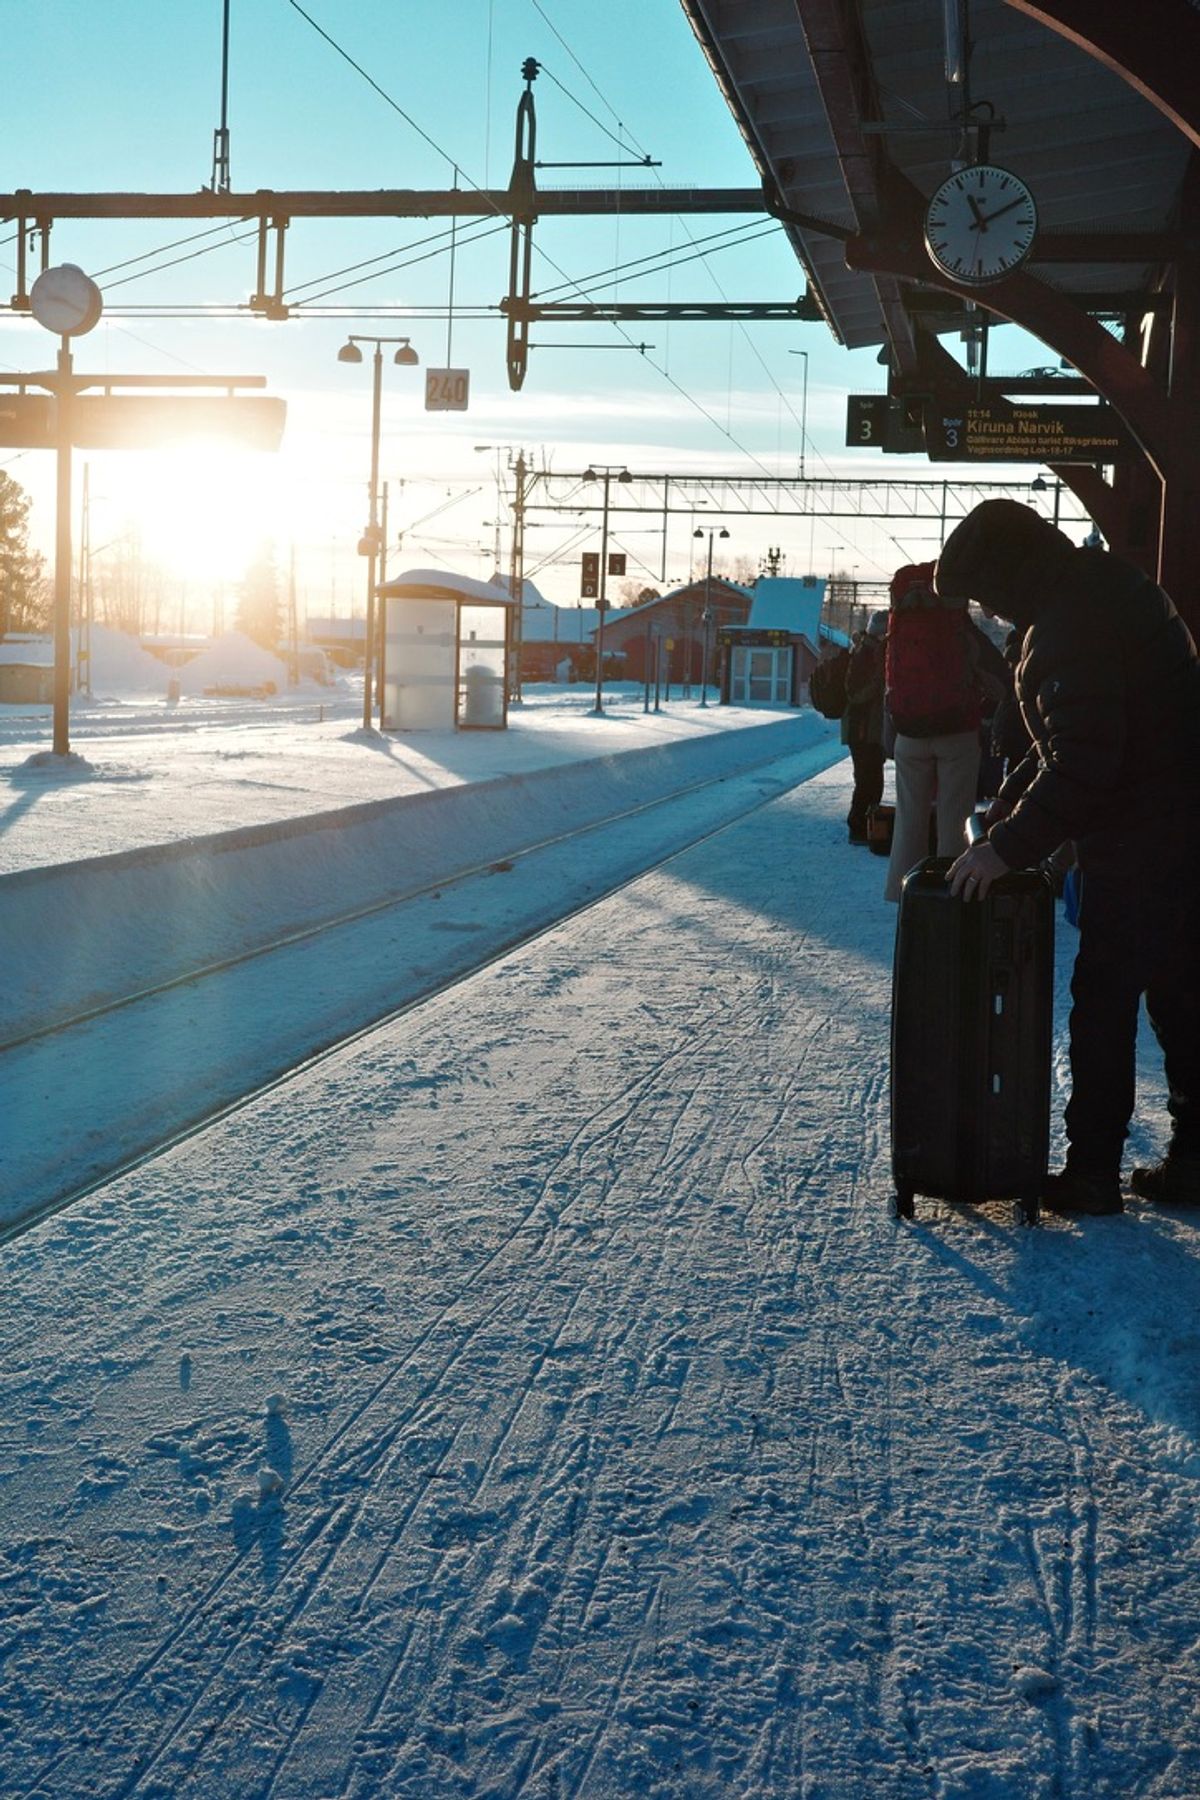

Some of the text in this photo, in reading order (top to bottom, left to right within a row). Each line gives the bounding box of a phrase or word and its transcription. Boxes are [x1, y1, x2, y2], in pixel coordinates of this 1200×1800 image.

[428, 376, 466, 402] 240
[967, 410, 991, 418] 11:14
[860, 420, 872, 440] 3
[967, 420, 1065, 434] Kiruna Narvik
[946, 429, 958, 447] 3
[1006, 436, 1037, 445] Abisko
